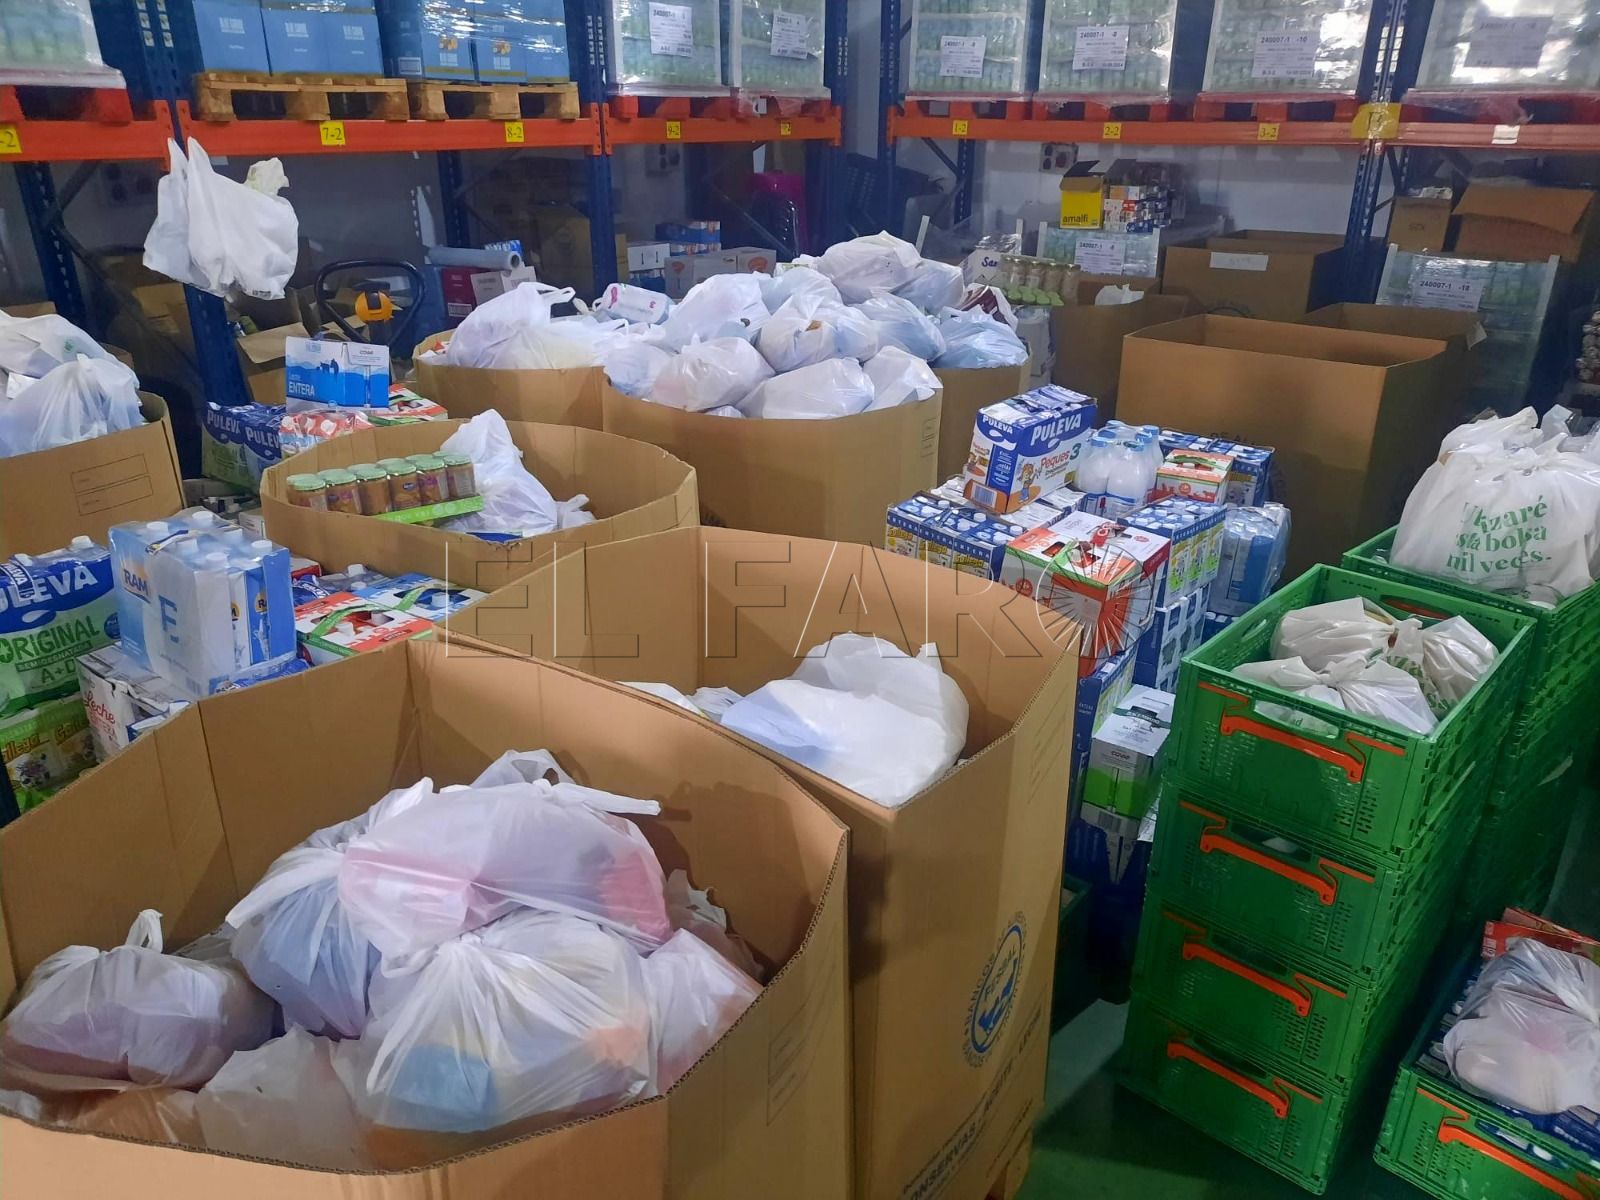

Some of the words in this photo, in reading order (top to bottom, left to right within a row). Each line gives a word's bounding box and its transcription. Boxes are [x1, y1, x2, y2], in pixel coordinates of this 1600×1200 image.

[322, 127, 343, 141] 7-2
[506, 126, 523, 139] 8-2
[1104, 126, 1120, 137] 2-2
[1260, 126, 1278, 138] 3-2
[1063, 213, 1089, 223] amalfi
[288, 381, 316, 396] ENTERA
[982, 414, 1014, 434] PULEVA
[1030, 413, 1082, 447] PULEVA
[245, 426, 280, 449] PULEV
[1040, 450, 1070, 469] Peques
[1069, 443, 1082, 460] 3
